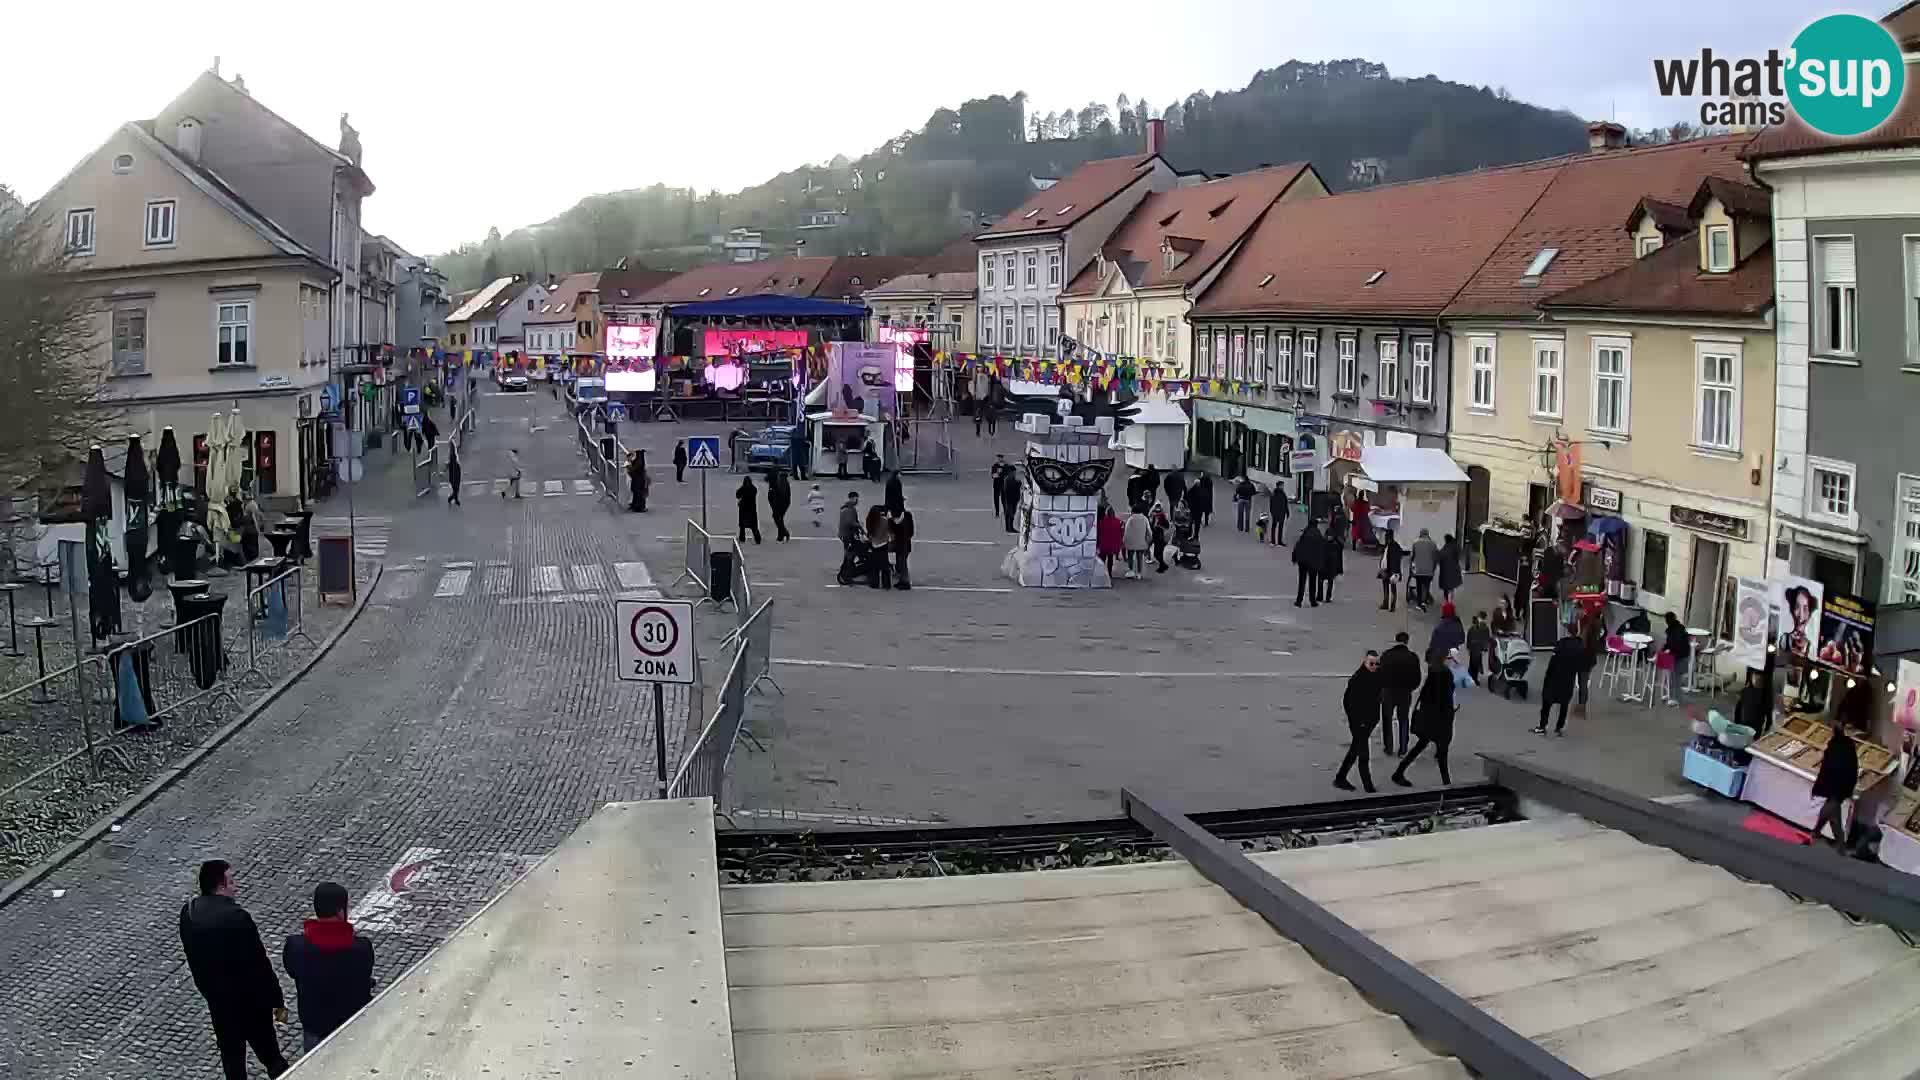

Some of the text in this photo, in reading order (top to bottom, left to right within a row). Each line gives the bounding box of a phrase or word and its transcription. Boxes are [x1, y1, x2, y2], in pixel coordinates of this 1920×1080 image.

[408, 392, 416, 402] P
[643, 623, 667, 644] 30
[634, 659, 679, 677] ZONA
